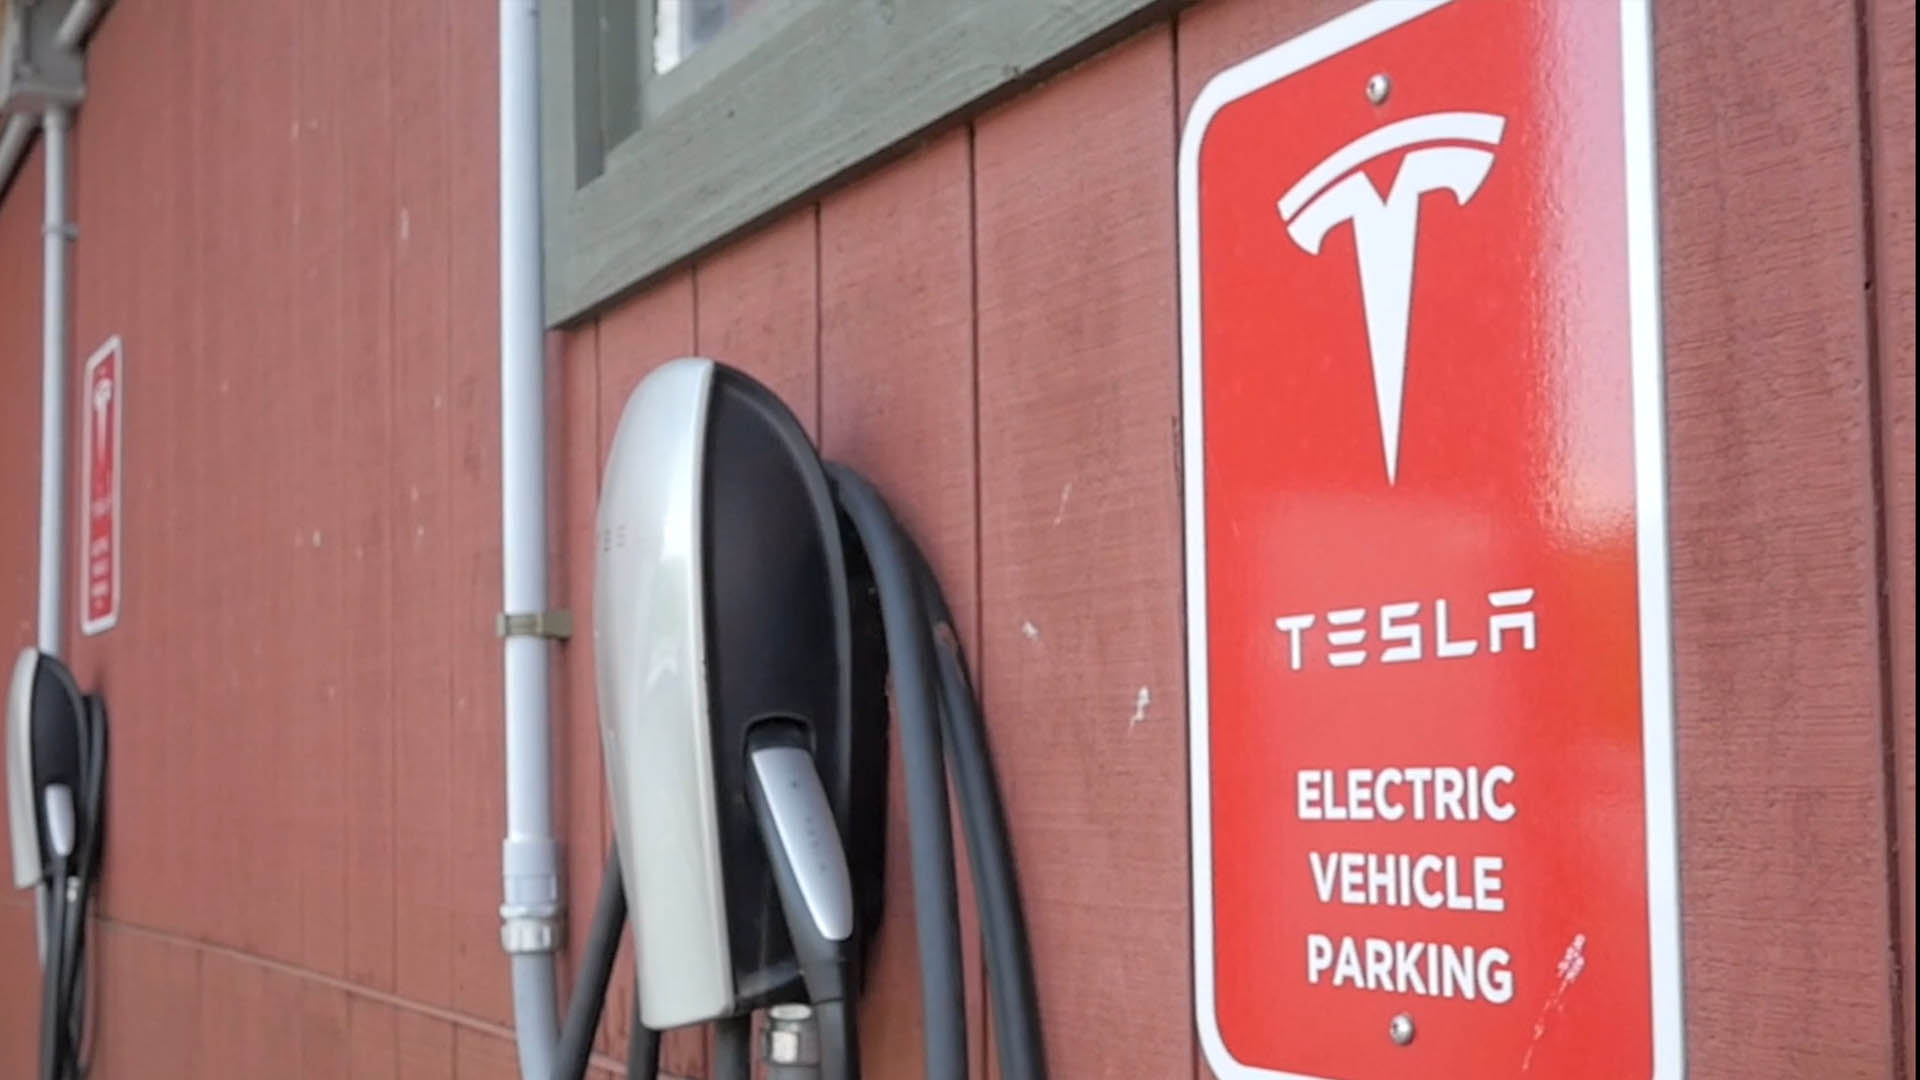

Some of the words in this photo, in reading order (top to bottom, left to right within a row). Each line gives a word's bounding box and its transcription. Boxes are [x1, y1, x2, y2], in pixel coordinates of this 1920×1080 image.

[1275, 588, 1536, 671] TESLA
[1296, 765, 1517, 822] ELECTRIC
[1309, 852, 1505, 912] VEHICLE
[1306, 933, 1515, 1004] PARKING
